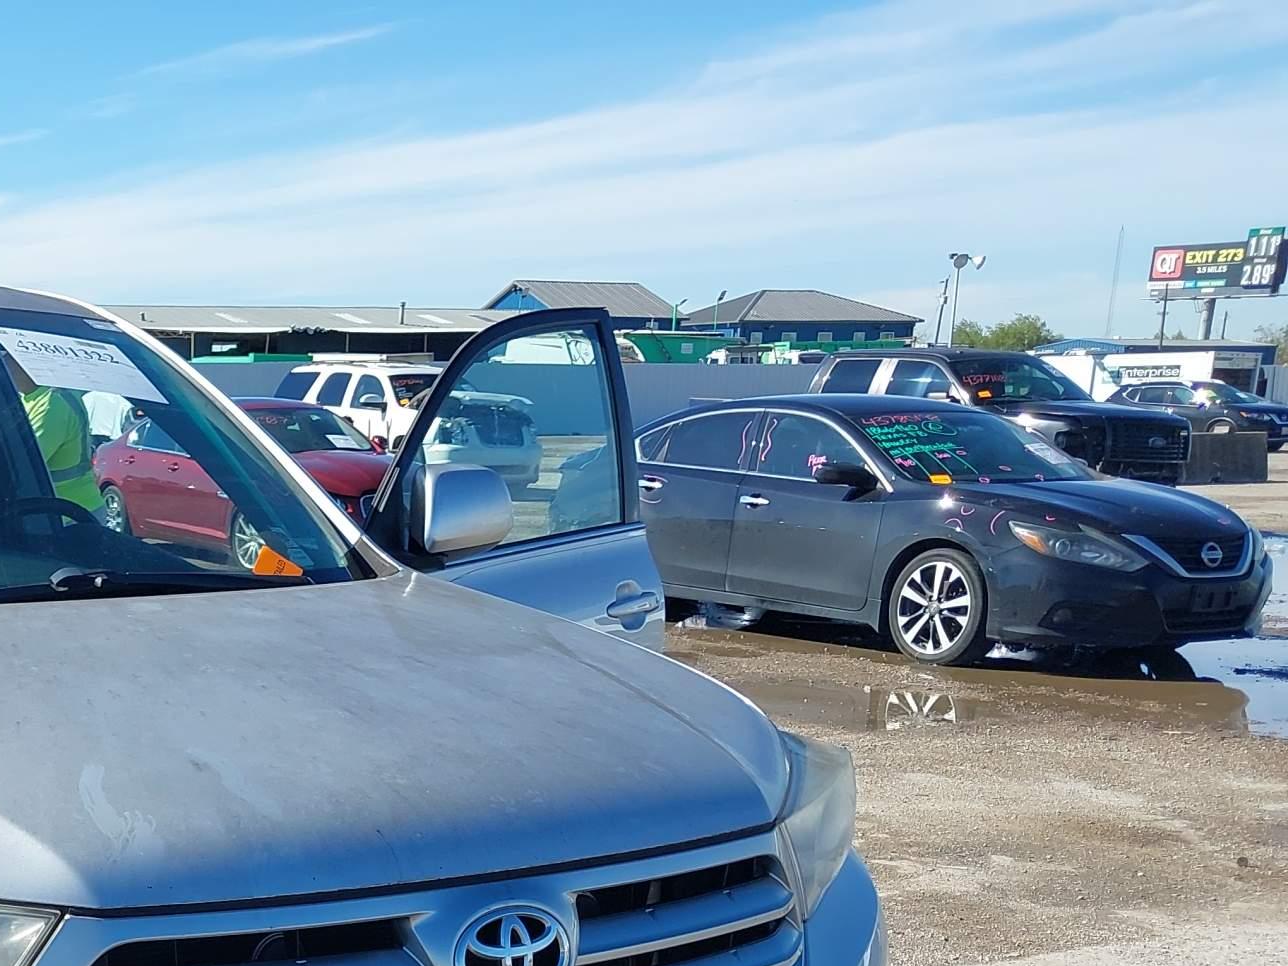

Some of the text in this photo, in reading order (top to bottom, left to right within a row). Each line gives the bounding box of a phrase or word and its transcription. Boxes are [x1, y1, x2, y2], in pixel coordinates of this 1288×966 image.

[1155, 253, 1181, 275] QT
[1184, 248, 1244, 264] EXIT 273
[1206, 265, 1228, 273] MILES
[15, 339, 120, 364] 43801322
[1119, 366, 1181, 379] Enterprise
